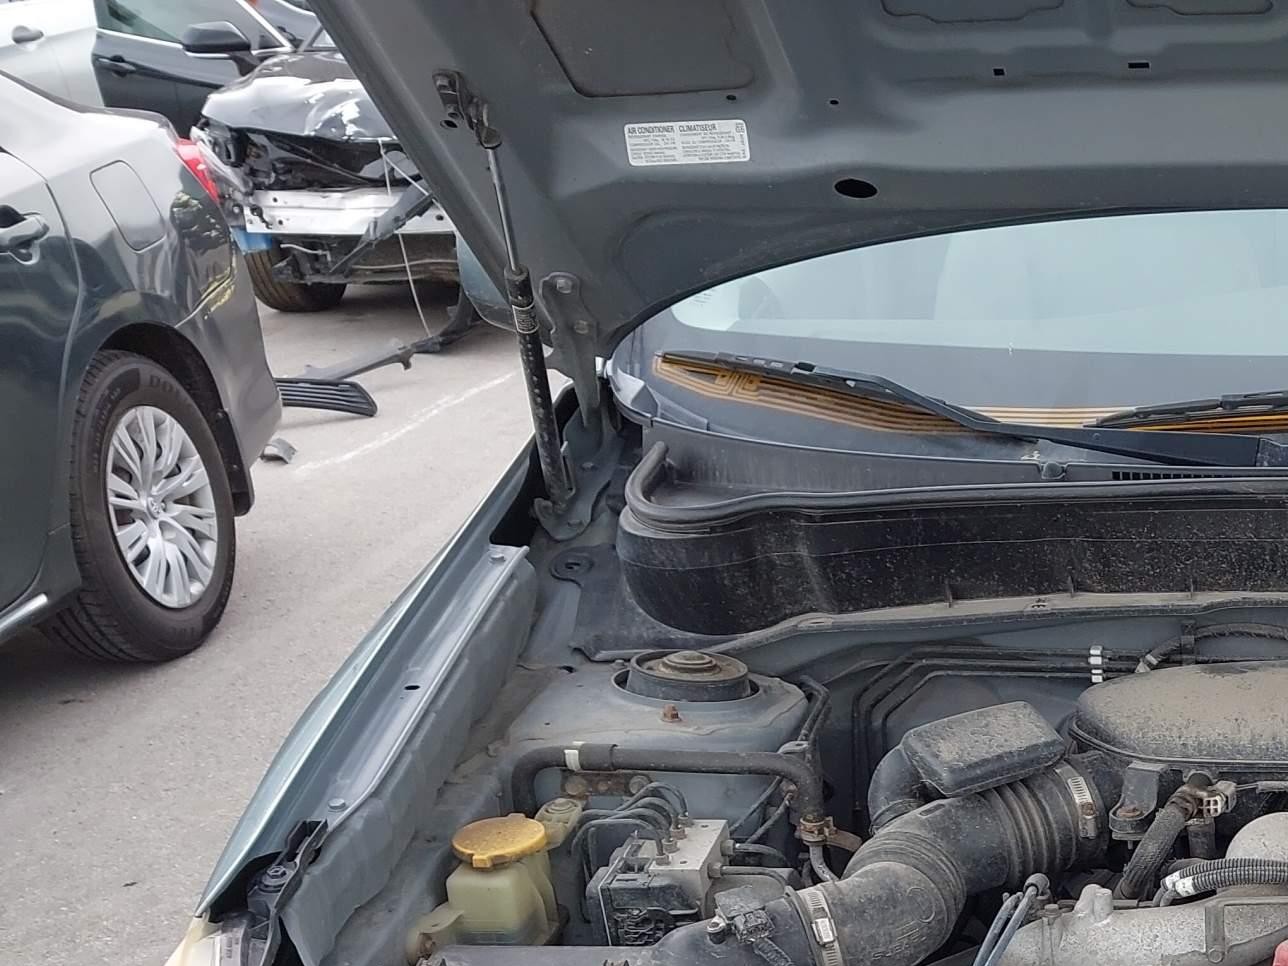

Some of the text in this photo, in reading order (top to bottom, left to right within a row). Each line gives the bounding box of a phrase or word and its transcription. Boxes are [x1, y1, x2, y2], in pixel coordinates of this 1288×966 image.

[628, 125, 675, 134] AIR CONDITIONER
[678, 123, 717, 132] CLIMATISEUR
